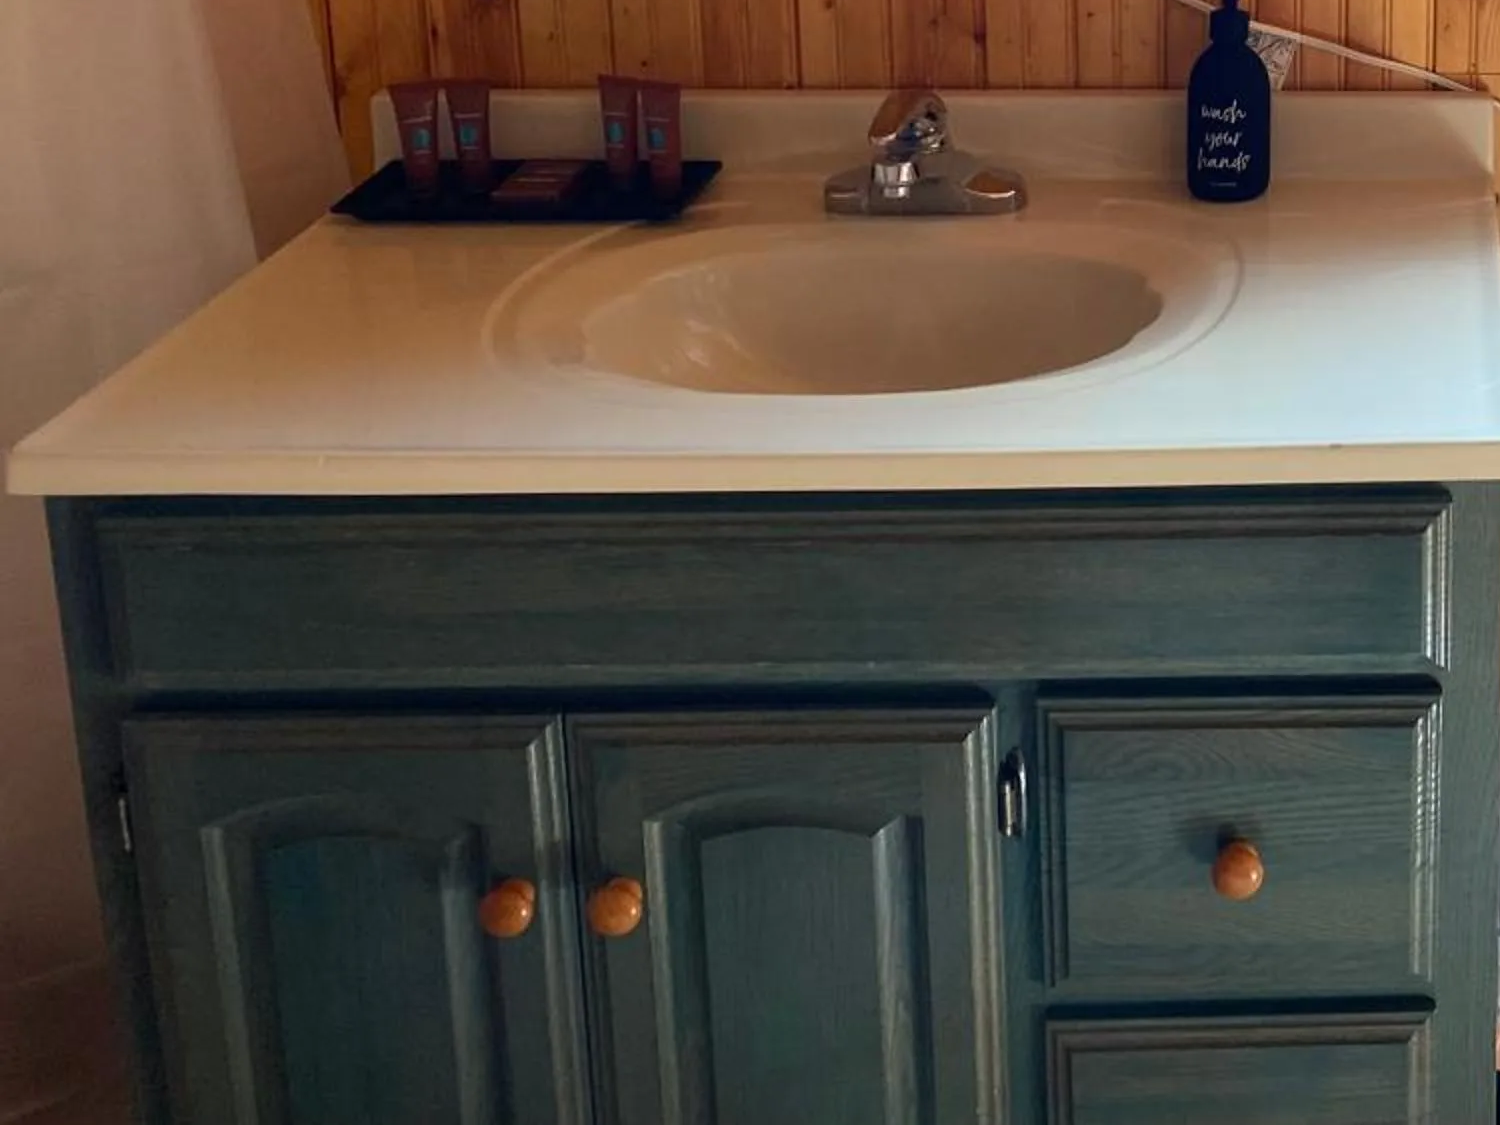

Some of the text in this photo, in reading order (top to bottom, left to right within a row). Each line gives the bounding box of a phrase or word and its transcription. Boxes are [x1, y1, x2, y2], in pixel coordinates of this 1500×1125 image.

[1201, 99, 1246, 124] wash
[1205, 131, 1242, 151] your
[1197, 148, 1250, 172] hands
